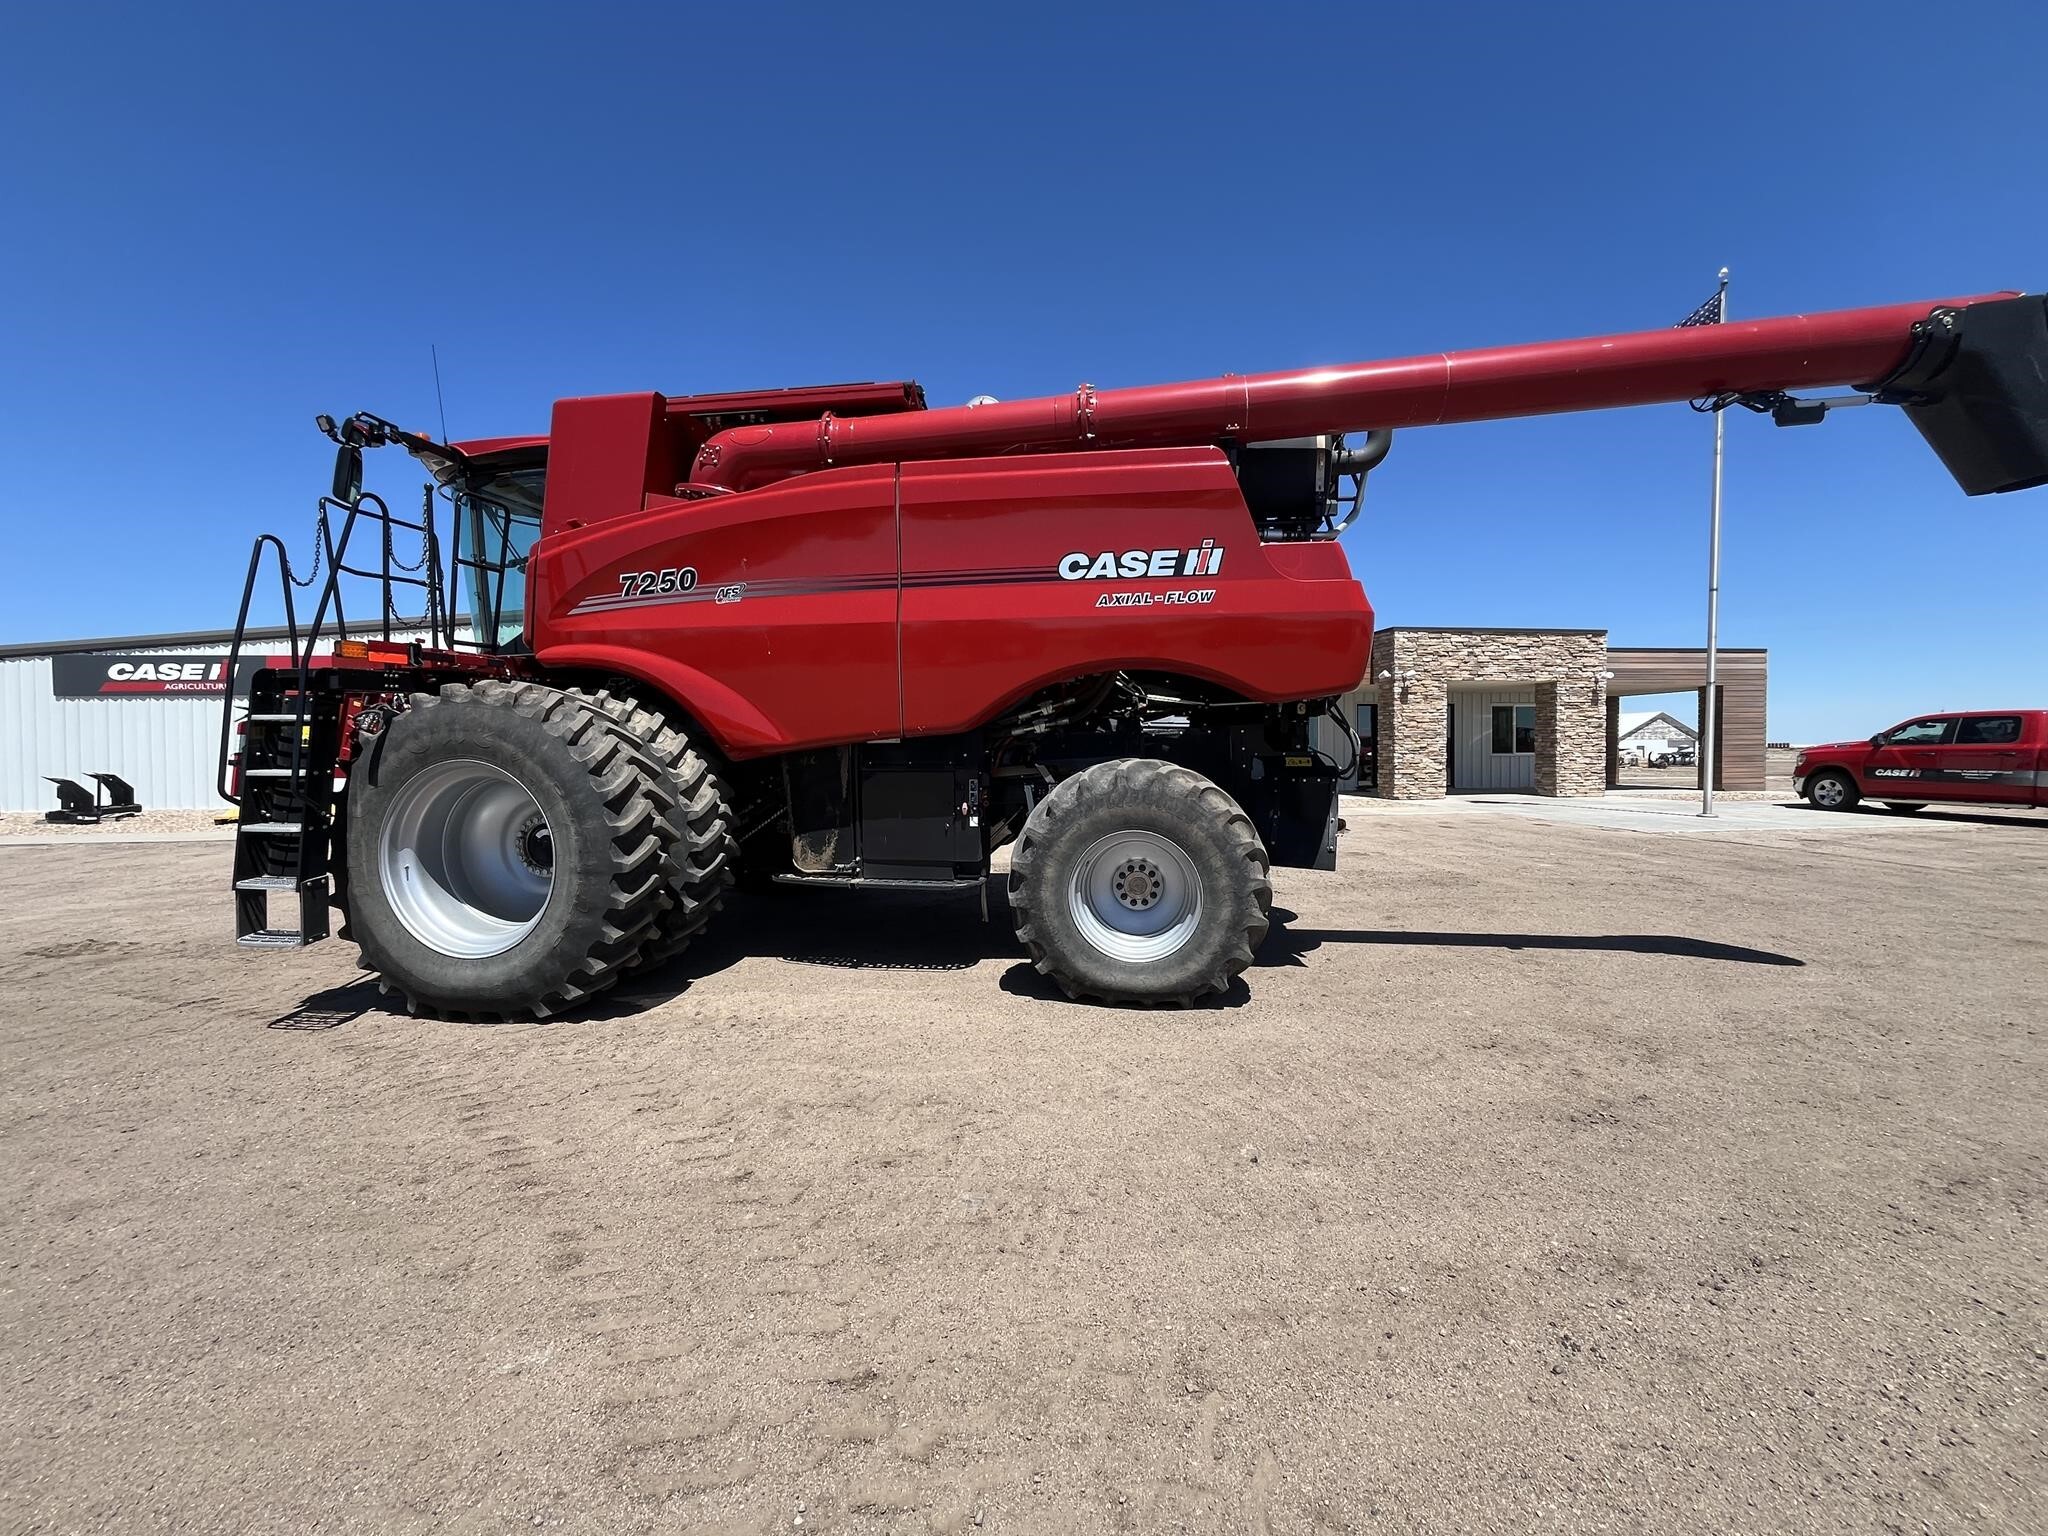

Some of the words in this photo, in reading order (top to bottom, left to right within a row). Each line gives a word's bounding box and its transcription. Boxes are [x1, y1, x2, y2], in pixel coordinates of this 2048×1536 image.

[1058, 550, 1180, 580] CASE
[619, 567, 698, 598] 7250
[714, 584, 743, 600] AFS
[107, 663, 206, 681] CASE
[1875, 769, 1910, 777] CASE
